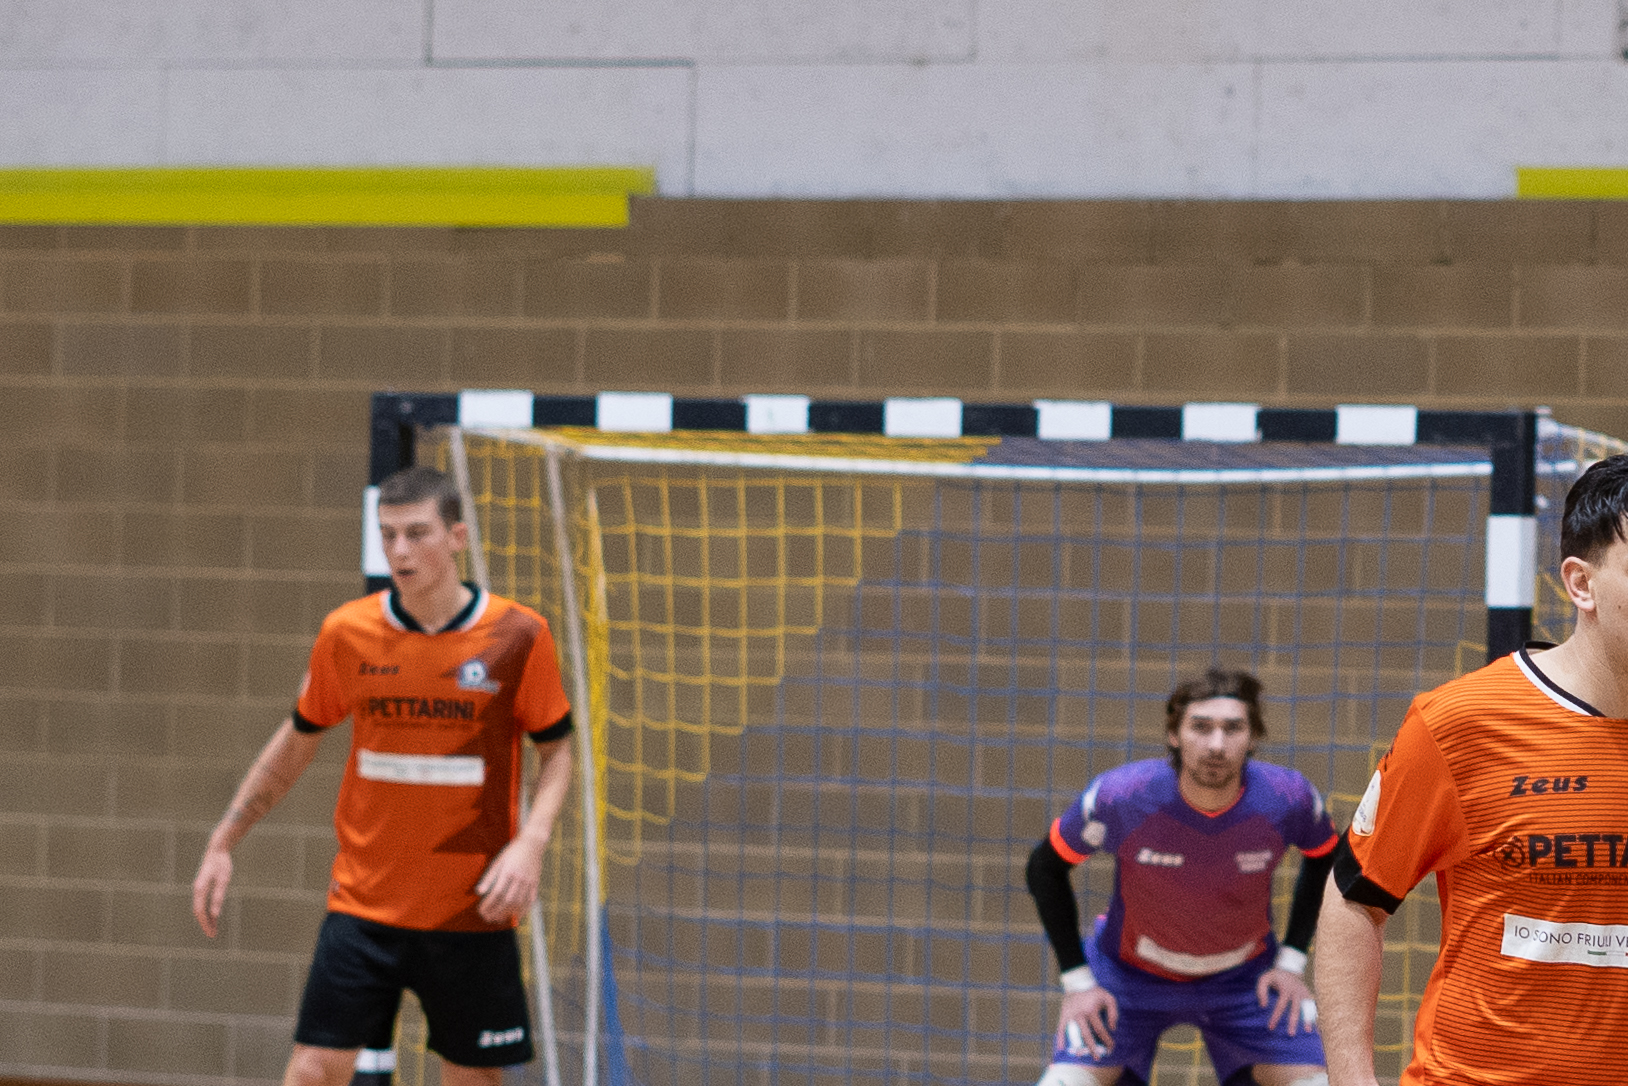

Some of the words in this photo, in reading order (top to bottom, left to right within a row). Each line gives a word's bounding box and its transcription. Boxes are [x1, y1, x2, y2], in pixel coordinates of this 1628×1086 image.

[369, 697, 474, 721] PETTARINI
[1510, 775, 1588, 796] Zeus
[1514, 926, 1530, 939] IO
[1533, 930, 1572, 944] SONO
[1577, 932, 1612, 947] FRIULI
